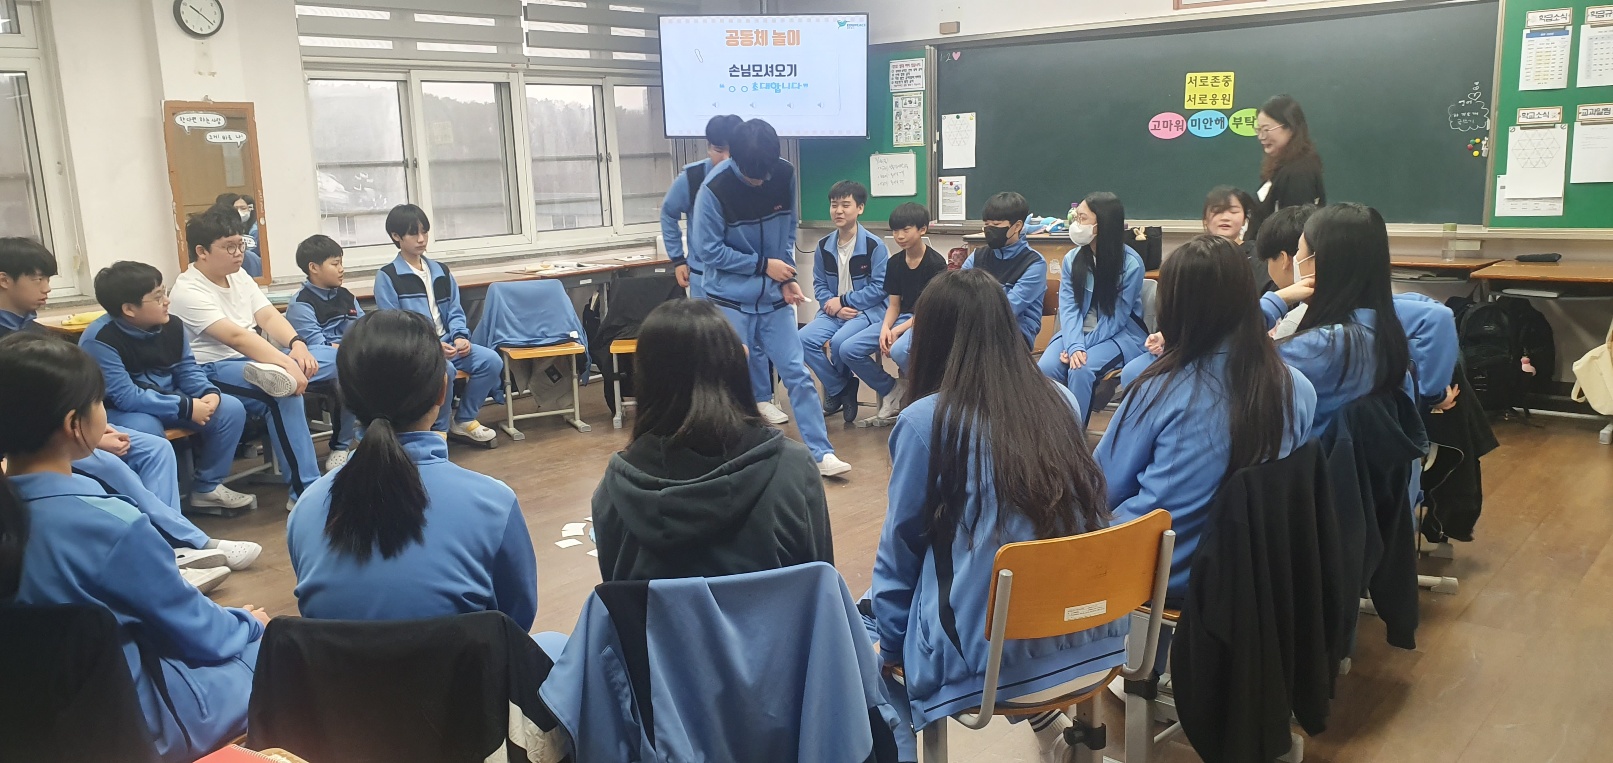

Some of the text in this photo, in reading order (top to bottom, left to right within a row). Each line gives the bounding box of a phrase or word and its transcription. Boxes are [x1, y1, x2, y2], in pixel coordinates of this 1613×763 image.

[1539, 13, 1568, 22] 학급소식
[1590, 9, 1613, 18] 학급규
[725, 29, 800, 46] 공동체 놀이
[728, 64, 797, 78] 손님모셔오기
[1187, 75, 1232, 87] 서로존중
[1186, 93, 1231, 106] 서로응원
[1521, 111, 1549, 119] 학교소식
[1150, 119, 1184, 132] 고마워
[1190, 116, 1225, 130] 미안해
[1232, 116, 1257, 129] 부탁
